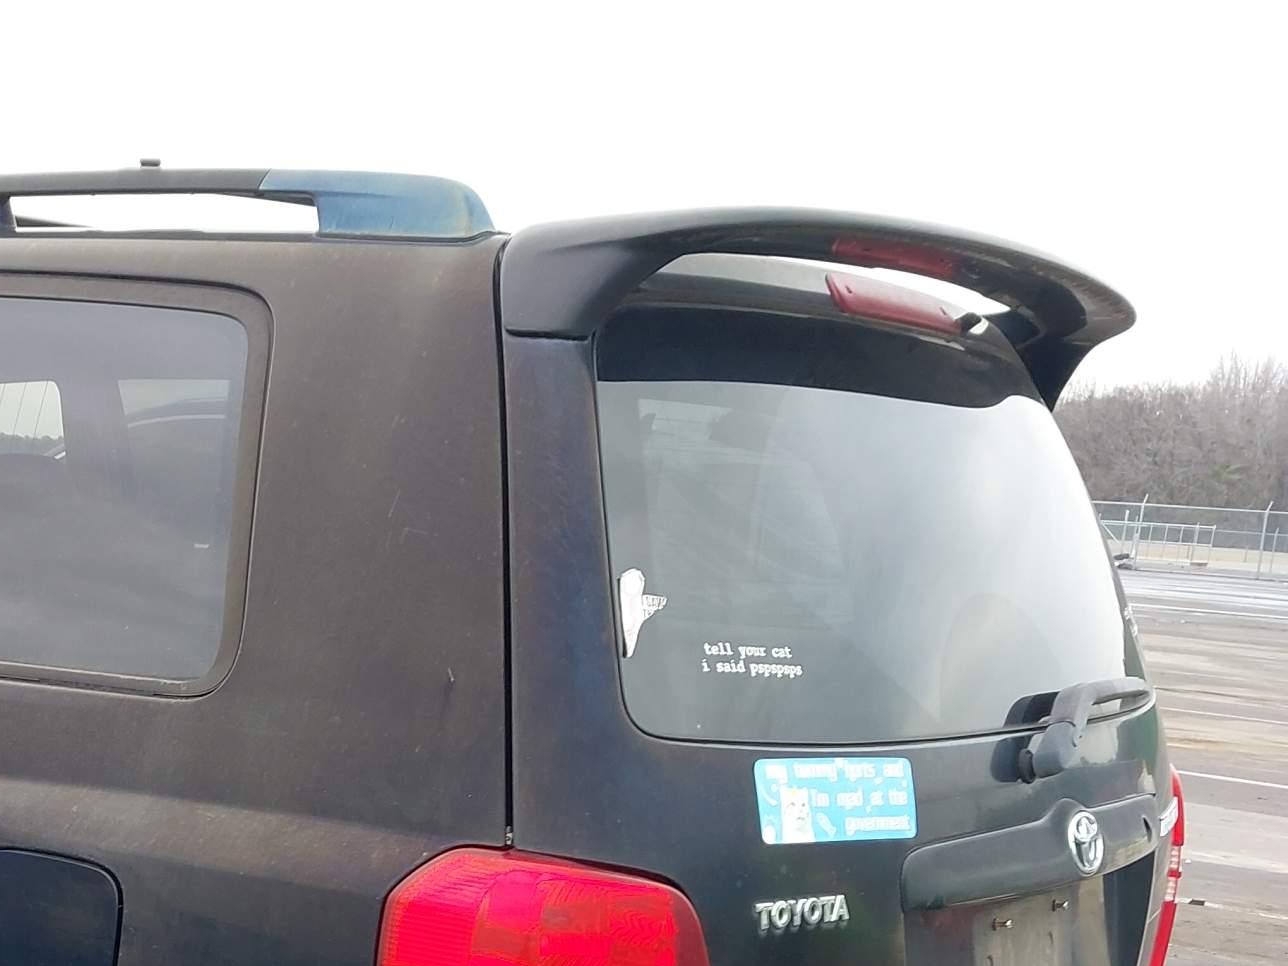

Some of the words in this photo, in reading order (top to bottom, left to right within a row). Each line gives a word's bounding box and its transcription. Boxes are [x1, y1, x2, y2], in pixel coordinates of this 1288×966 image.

[704, 642, 734, 655] tell
[738, 646, 767, 659] your
[771, 646, 793, 658] cat
[701, 658, 710, 672] i
[715, 659, 746, 673] said
[749, 663, 803, 678] pspspsps
[754, 894, 850, 930] TOYOTA
